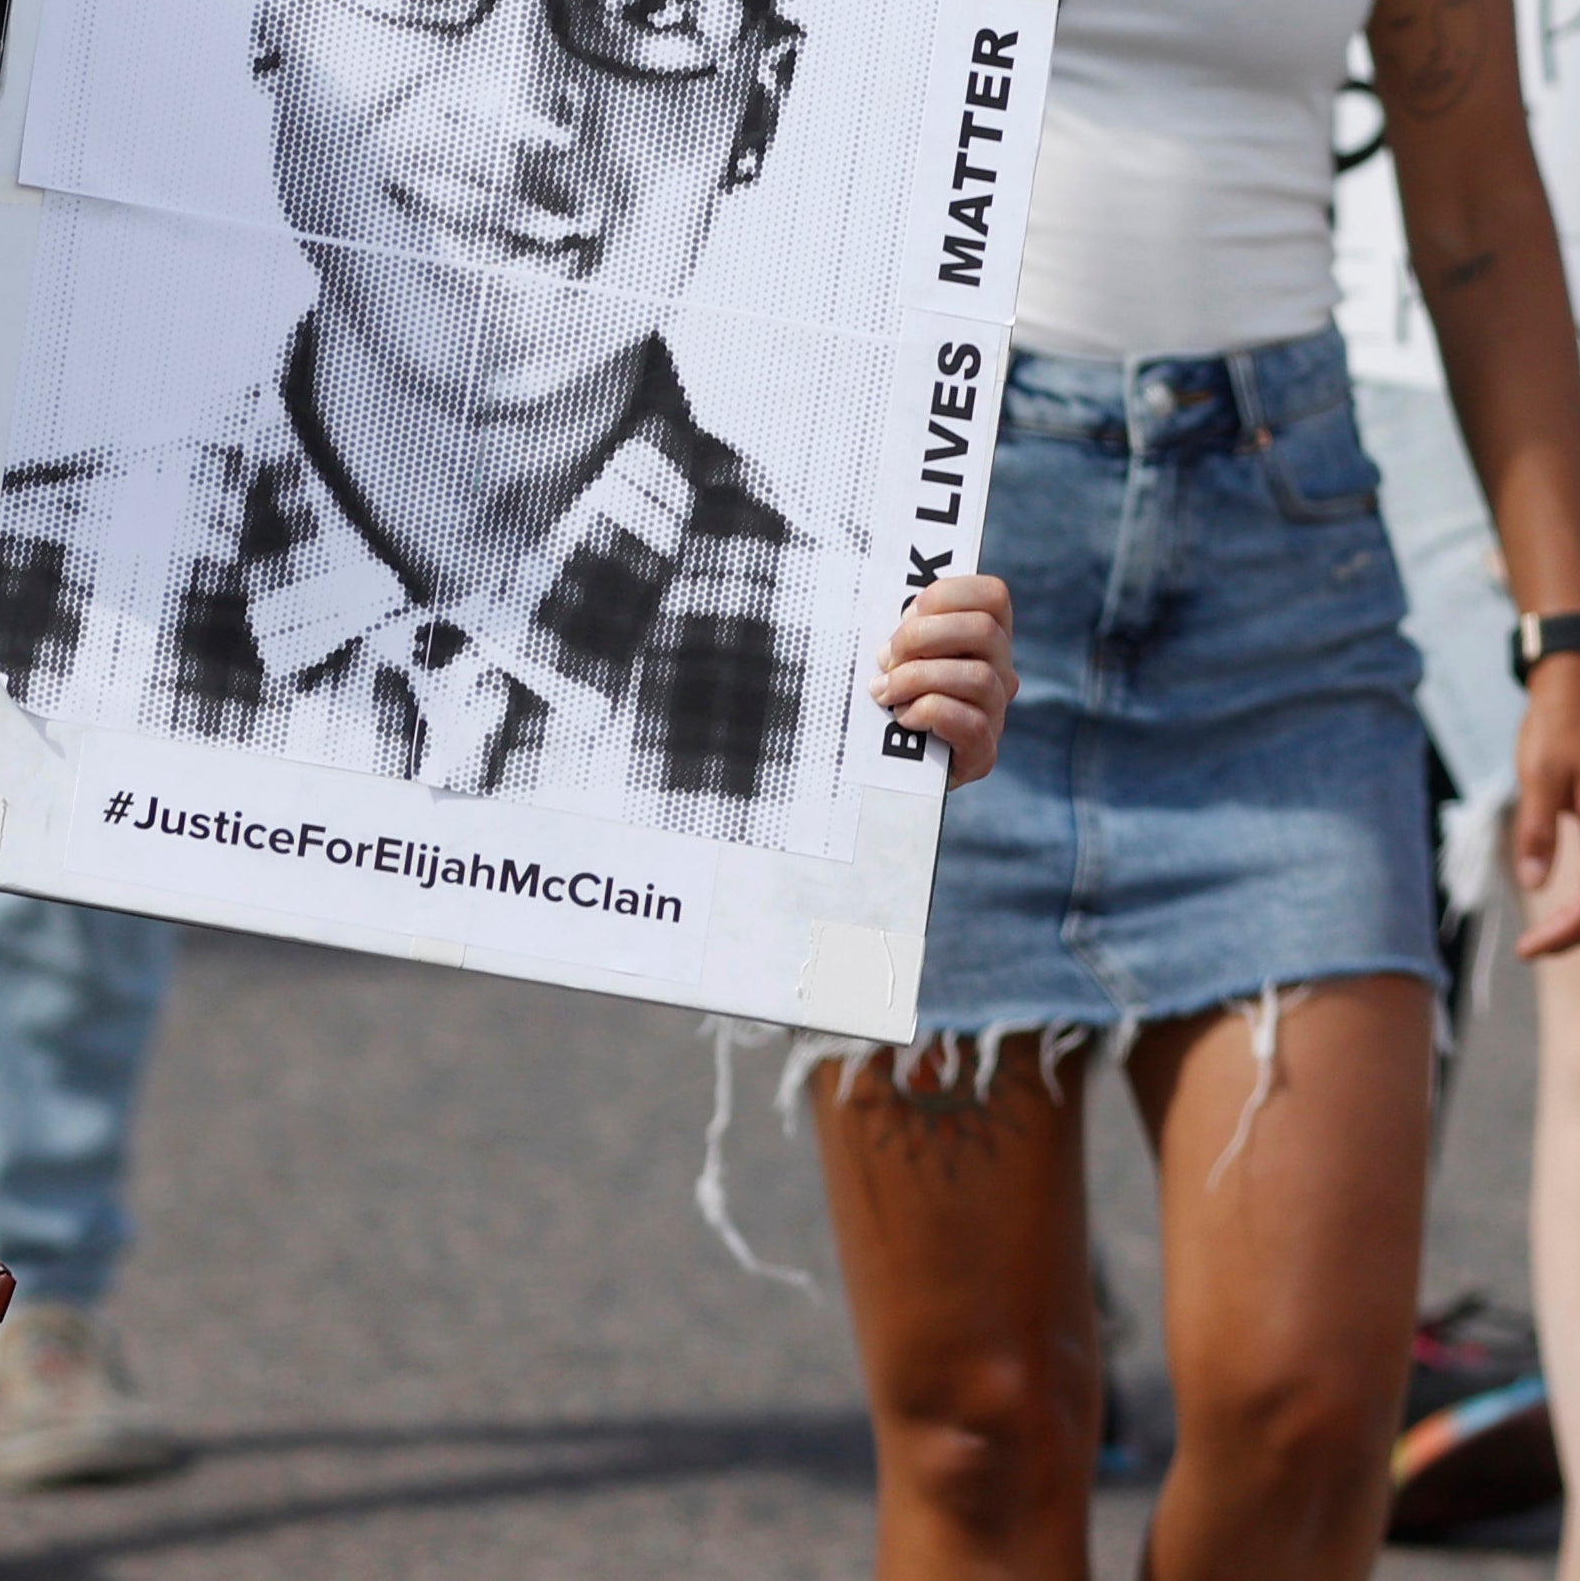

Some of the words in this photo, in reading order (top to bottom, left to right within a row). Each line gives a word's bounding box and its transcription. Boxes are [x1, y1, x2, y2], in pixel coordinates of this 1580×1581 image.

[937, 27, 1019, 288] MATTER
[915, 341, 982, 526] LIVES
[102, 790, 683, 924] #JusticeForElijahMcClain
